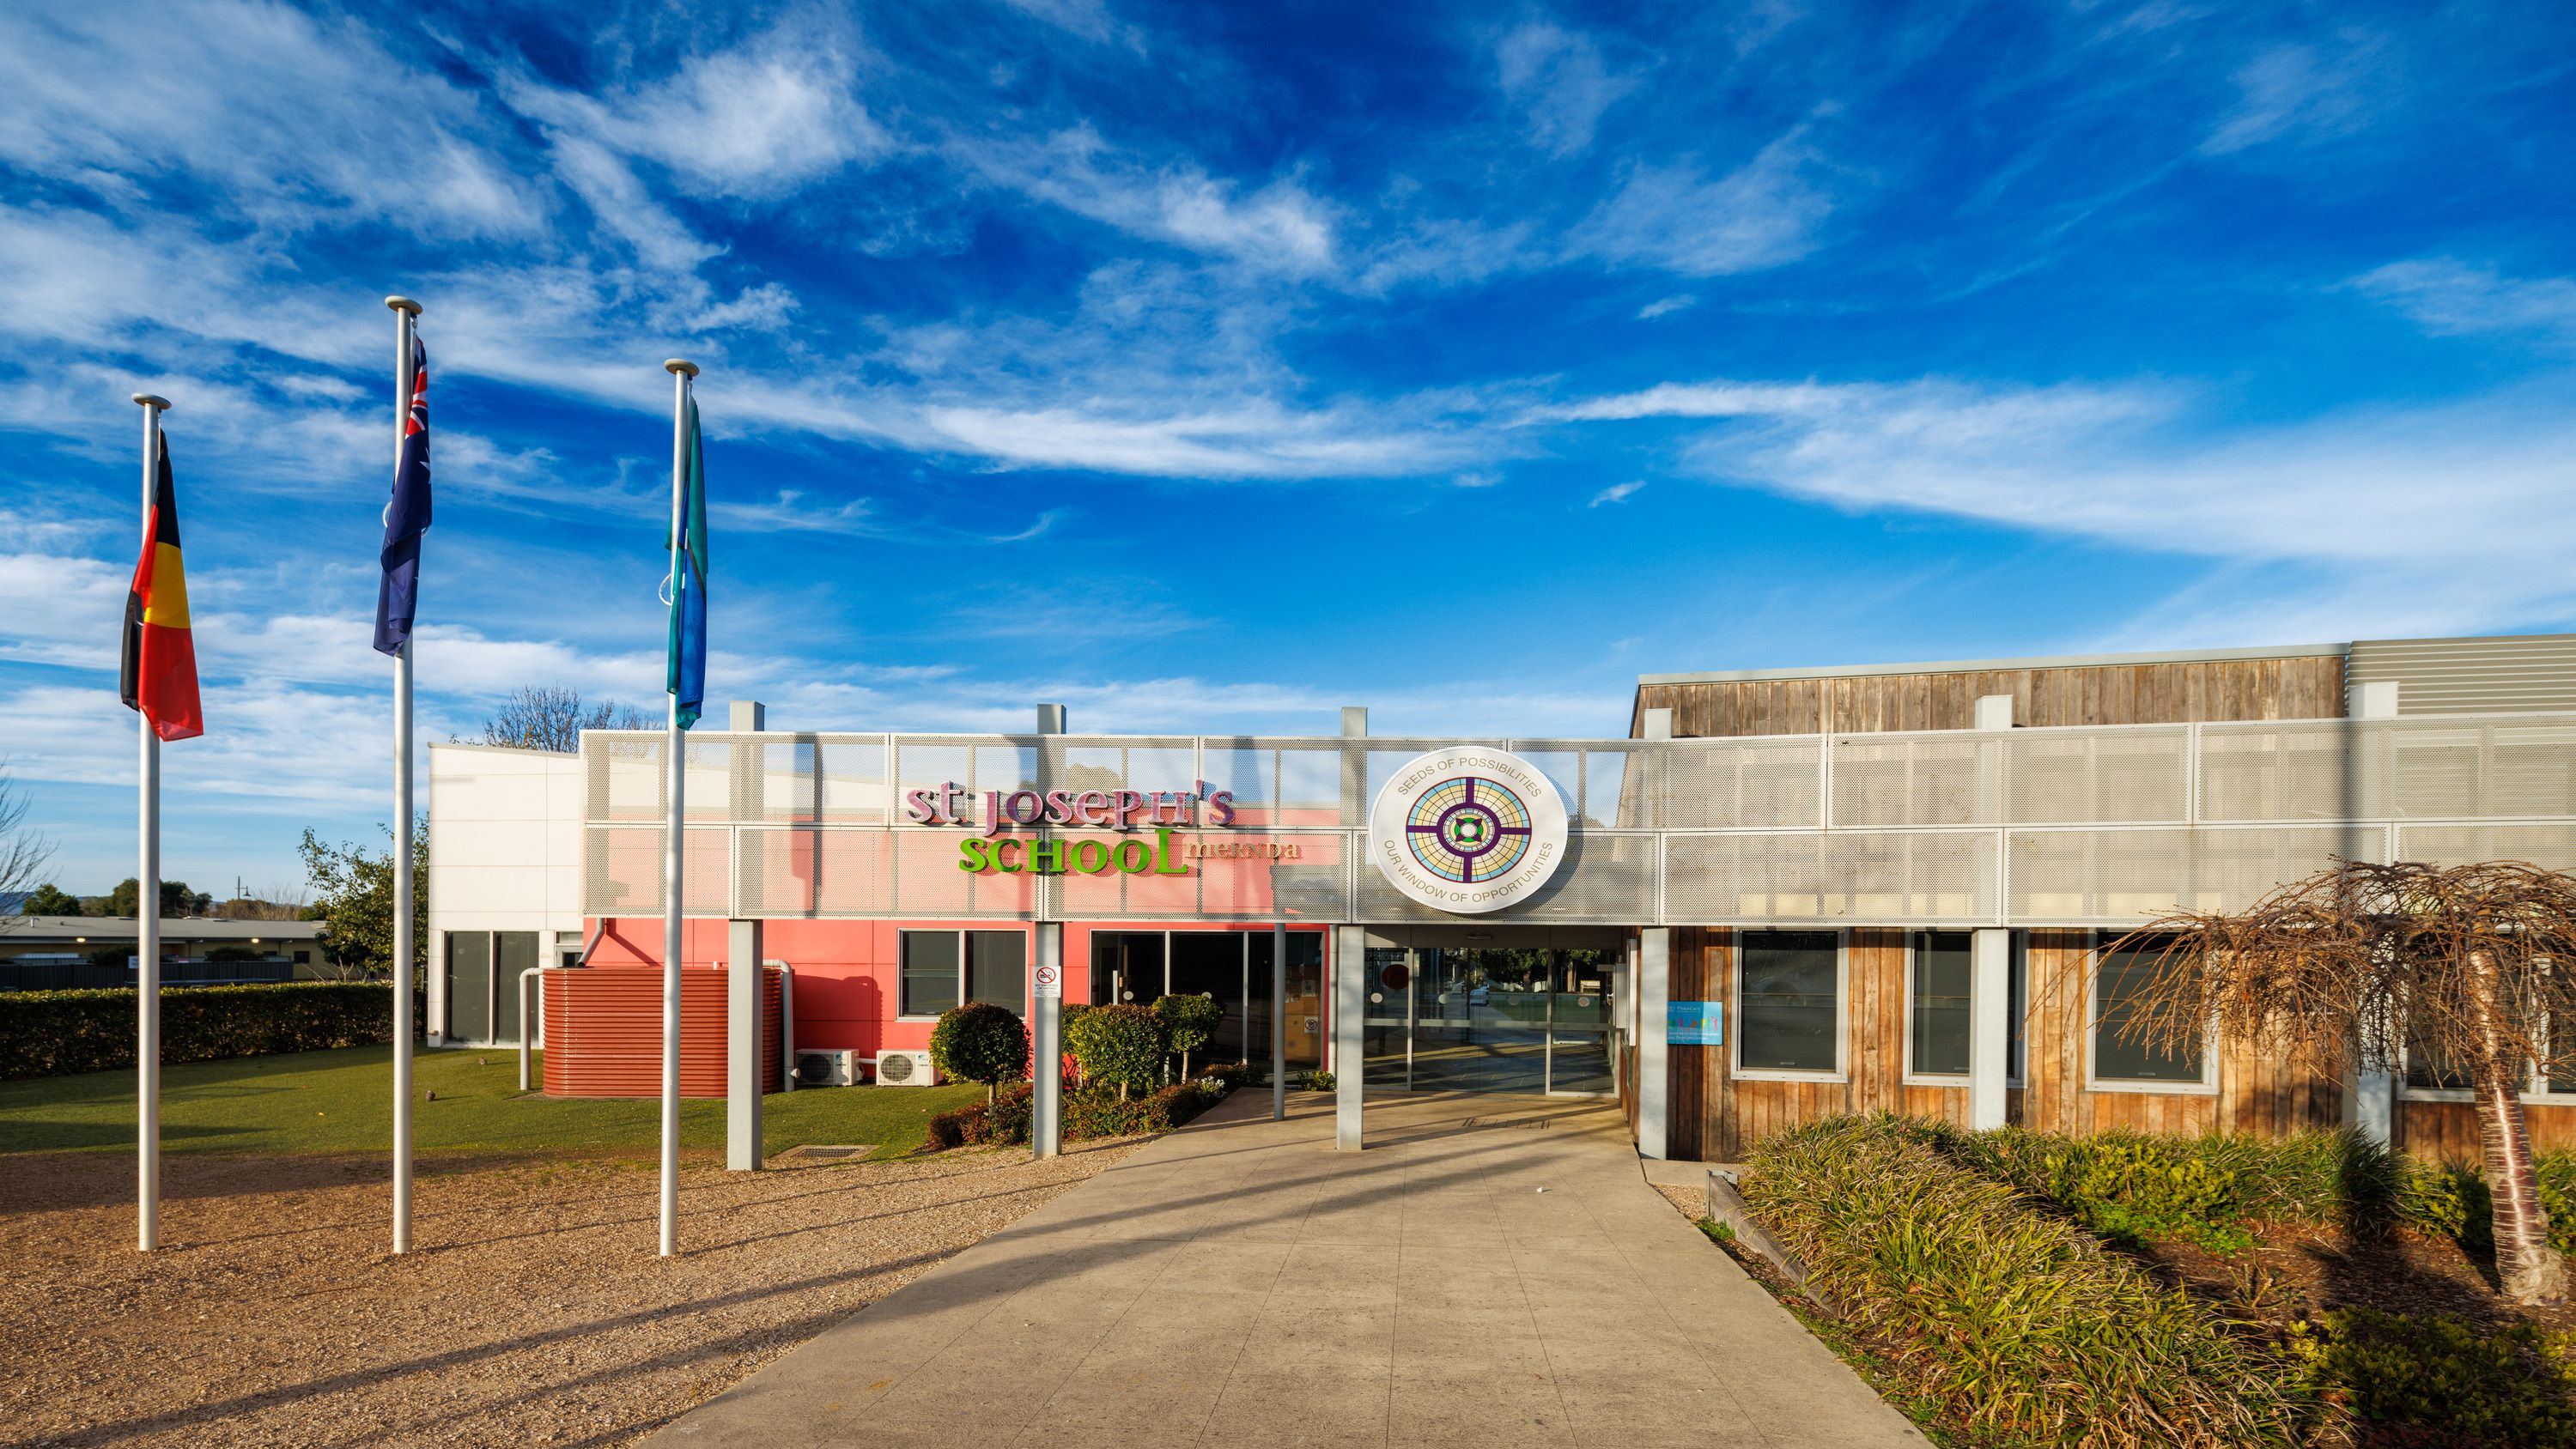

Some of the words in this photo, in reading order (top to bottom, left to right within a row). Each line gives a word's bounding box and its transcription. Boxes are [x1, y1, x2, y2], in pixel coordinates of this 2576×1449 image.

[1398, 765, 1436, 796] SEEDS
[1437, 758, 1455, 771] OF
[1459, 756, 1542, 797] POSSIBILITIES
[1384, 840, 1401, 866] OUR
[1398, 863, 1448, 900] WINDOW
[1449, 891, 1468, 902] OF
[1472, 841, 1553, 903] OPPORTUNITIES
